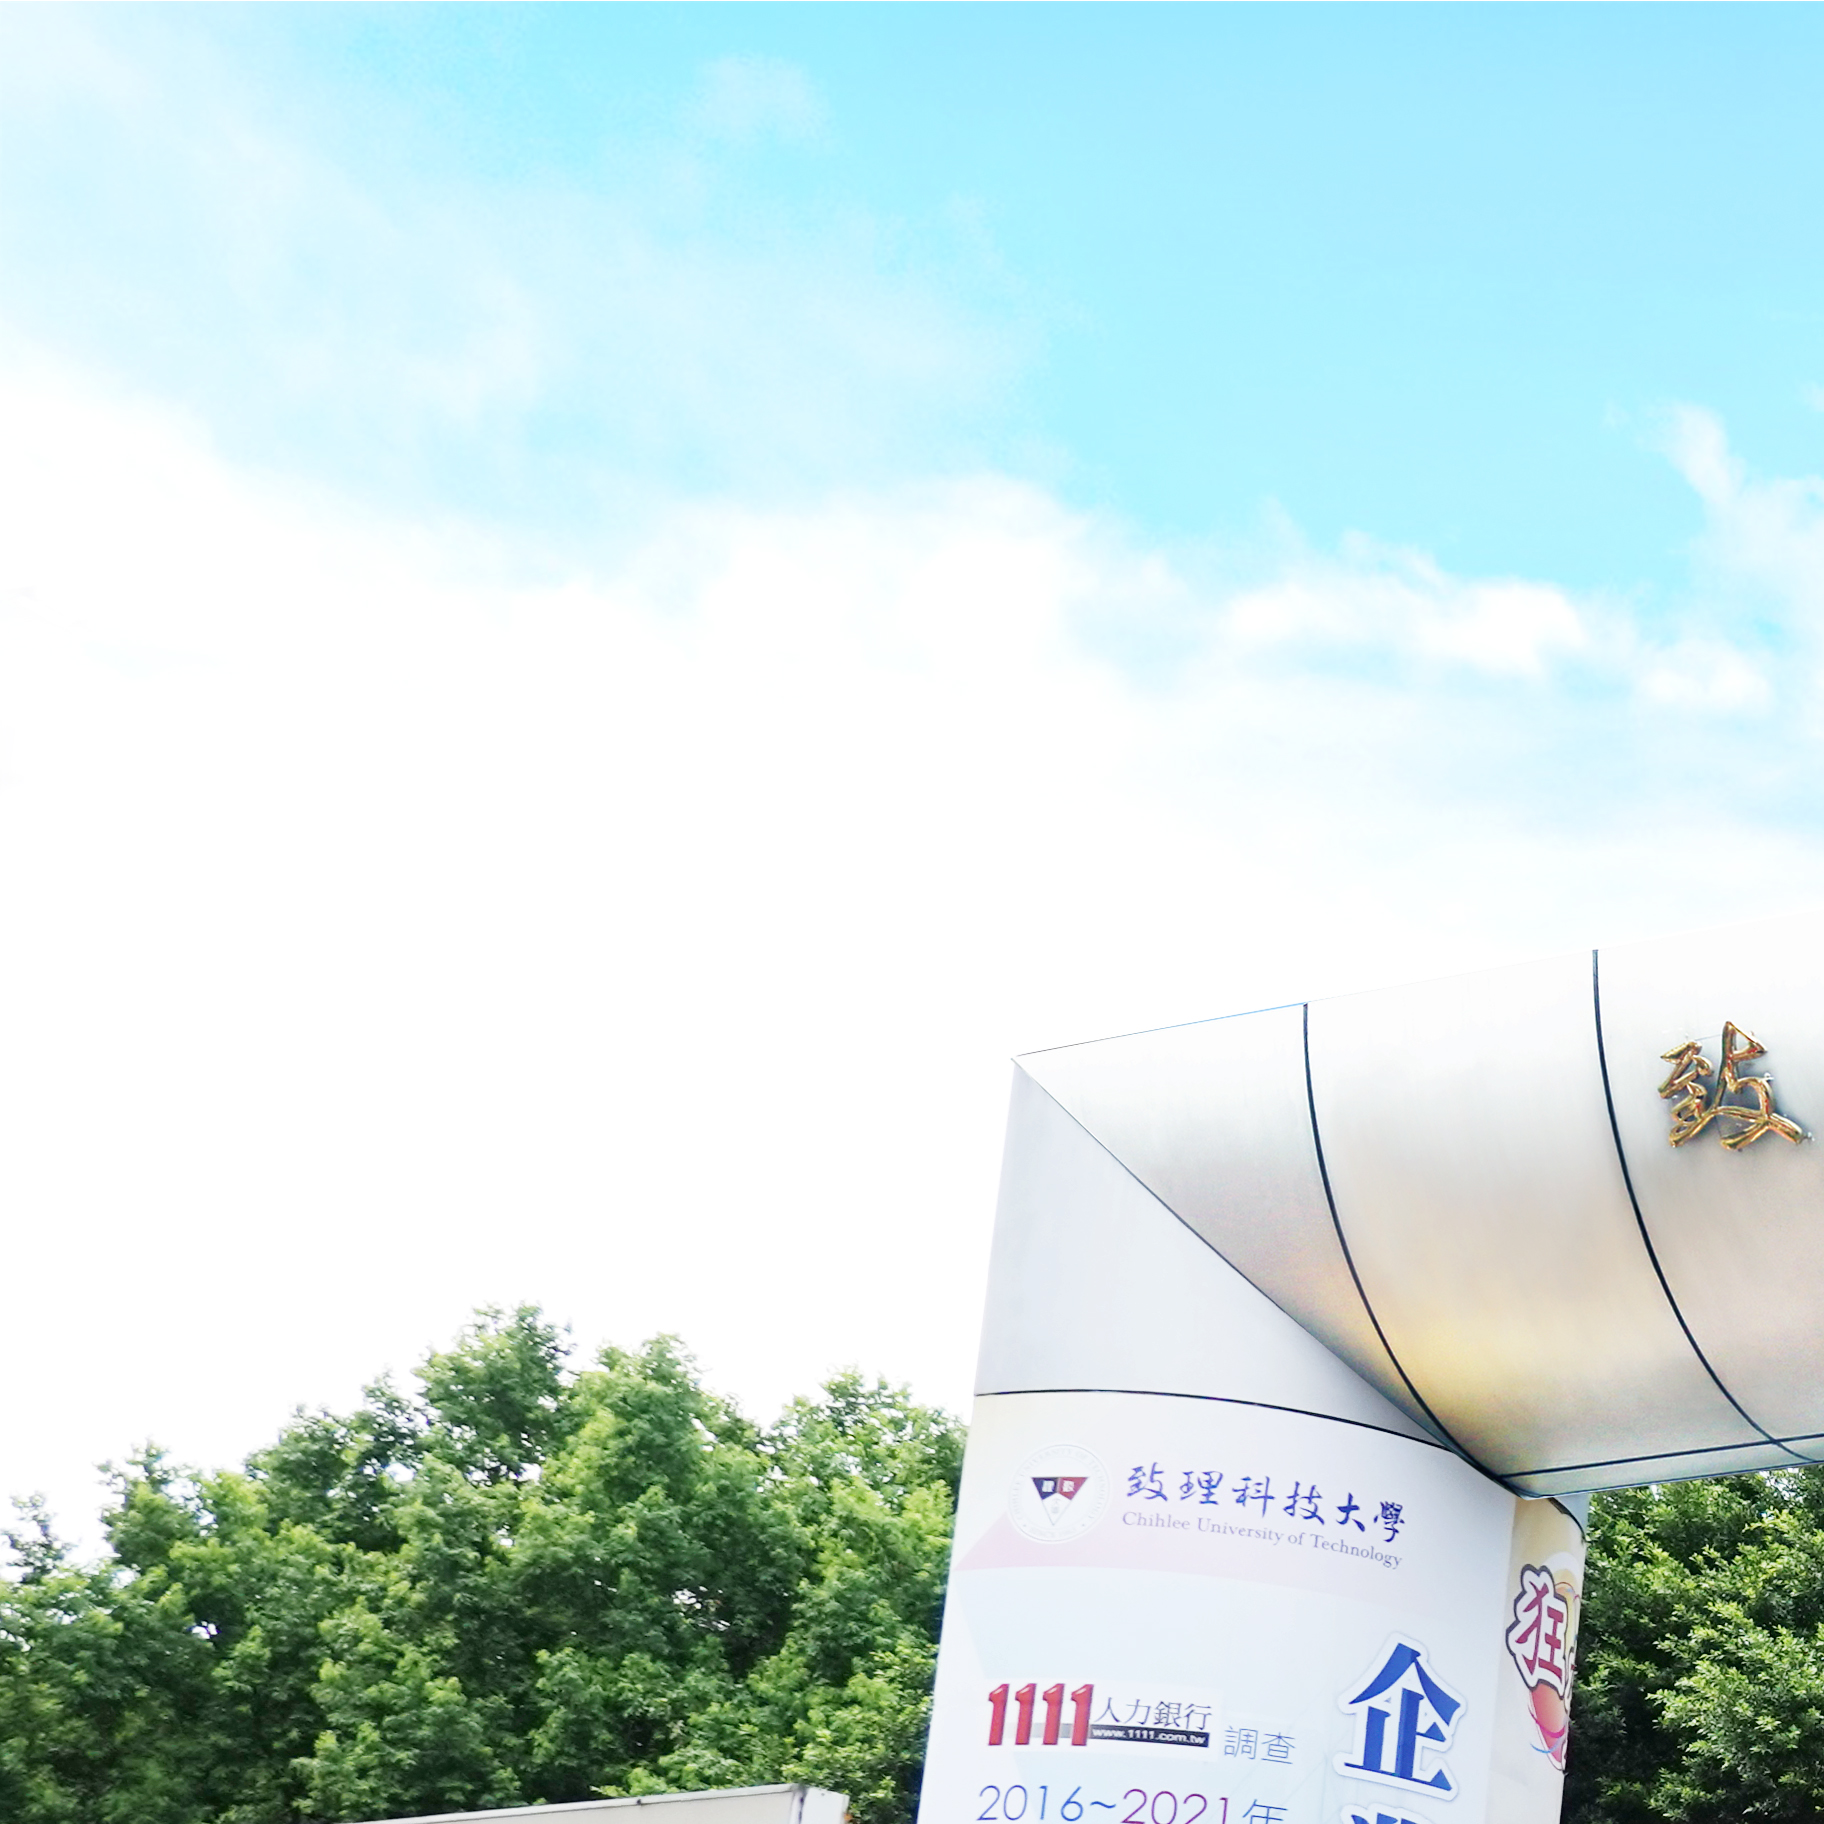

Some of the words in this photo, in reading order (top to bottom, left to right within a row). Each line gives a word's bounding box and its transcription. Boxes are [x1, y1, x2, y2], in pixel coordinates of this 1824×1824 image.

[1125, 1461, 1406, 1543] 致理科技大學
[1121, 1510, 1191, 1531] Chihlee
[1196, 1516, 1284, 1547] University
[1287, 1530, 1305, 1546] of
[1311, 1534, 1404, 1571] Technology
[987, 1682, 1095, 1747] 1111
[1094, 1696, 1214, 1732] 人力銀行
[1223, 1725, 1297, 1765] 調查
[1091, 1726, 1207, 1745] www.1111.com.tw
